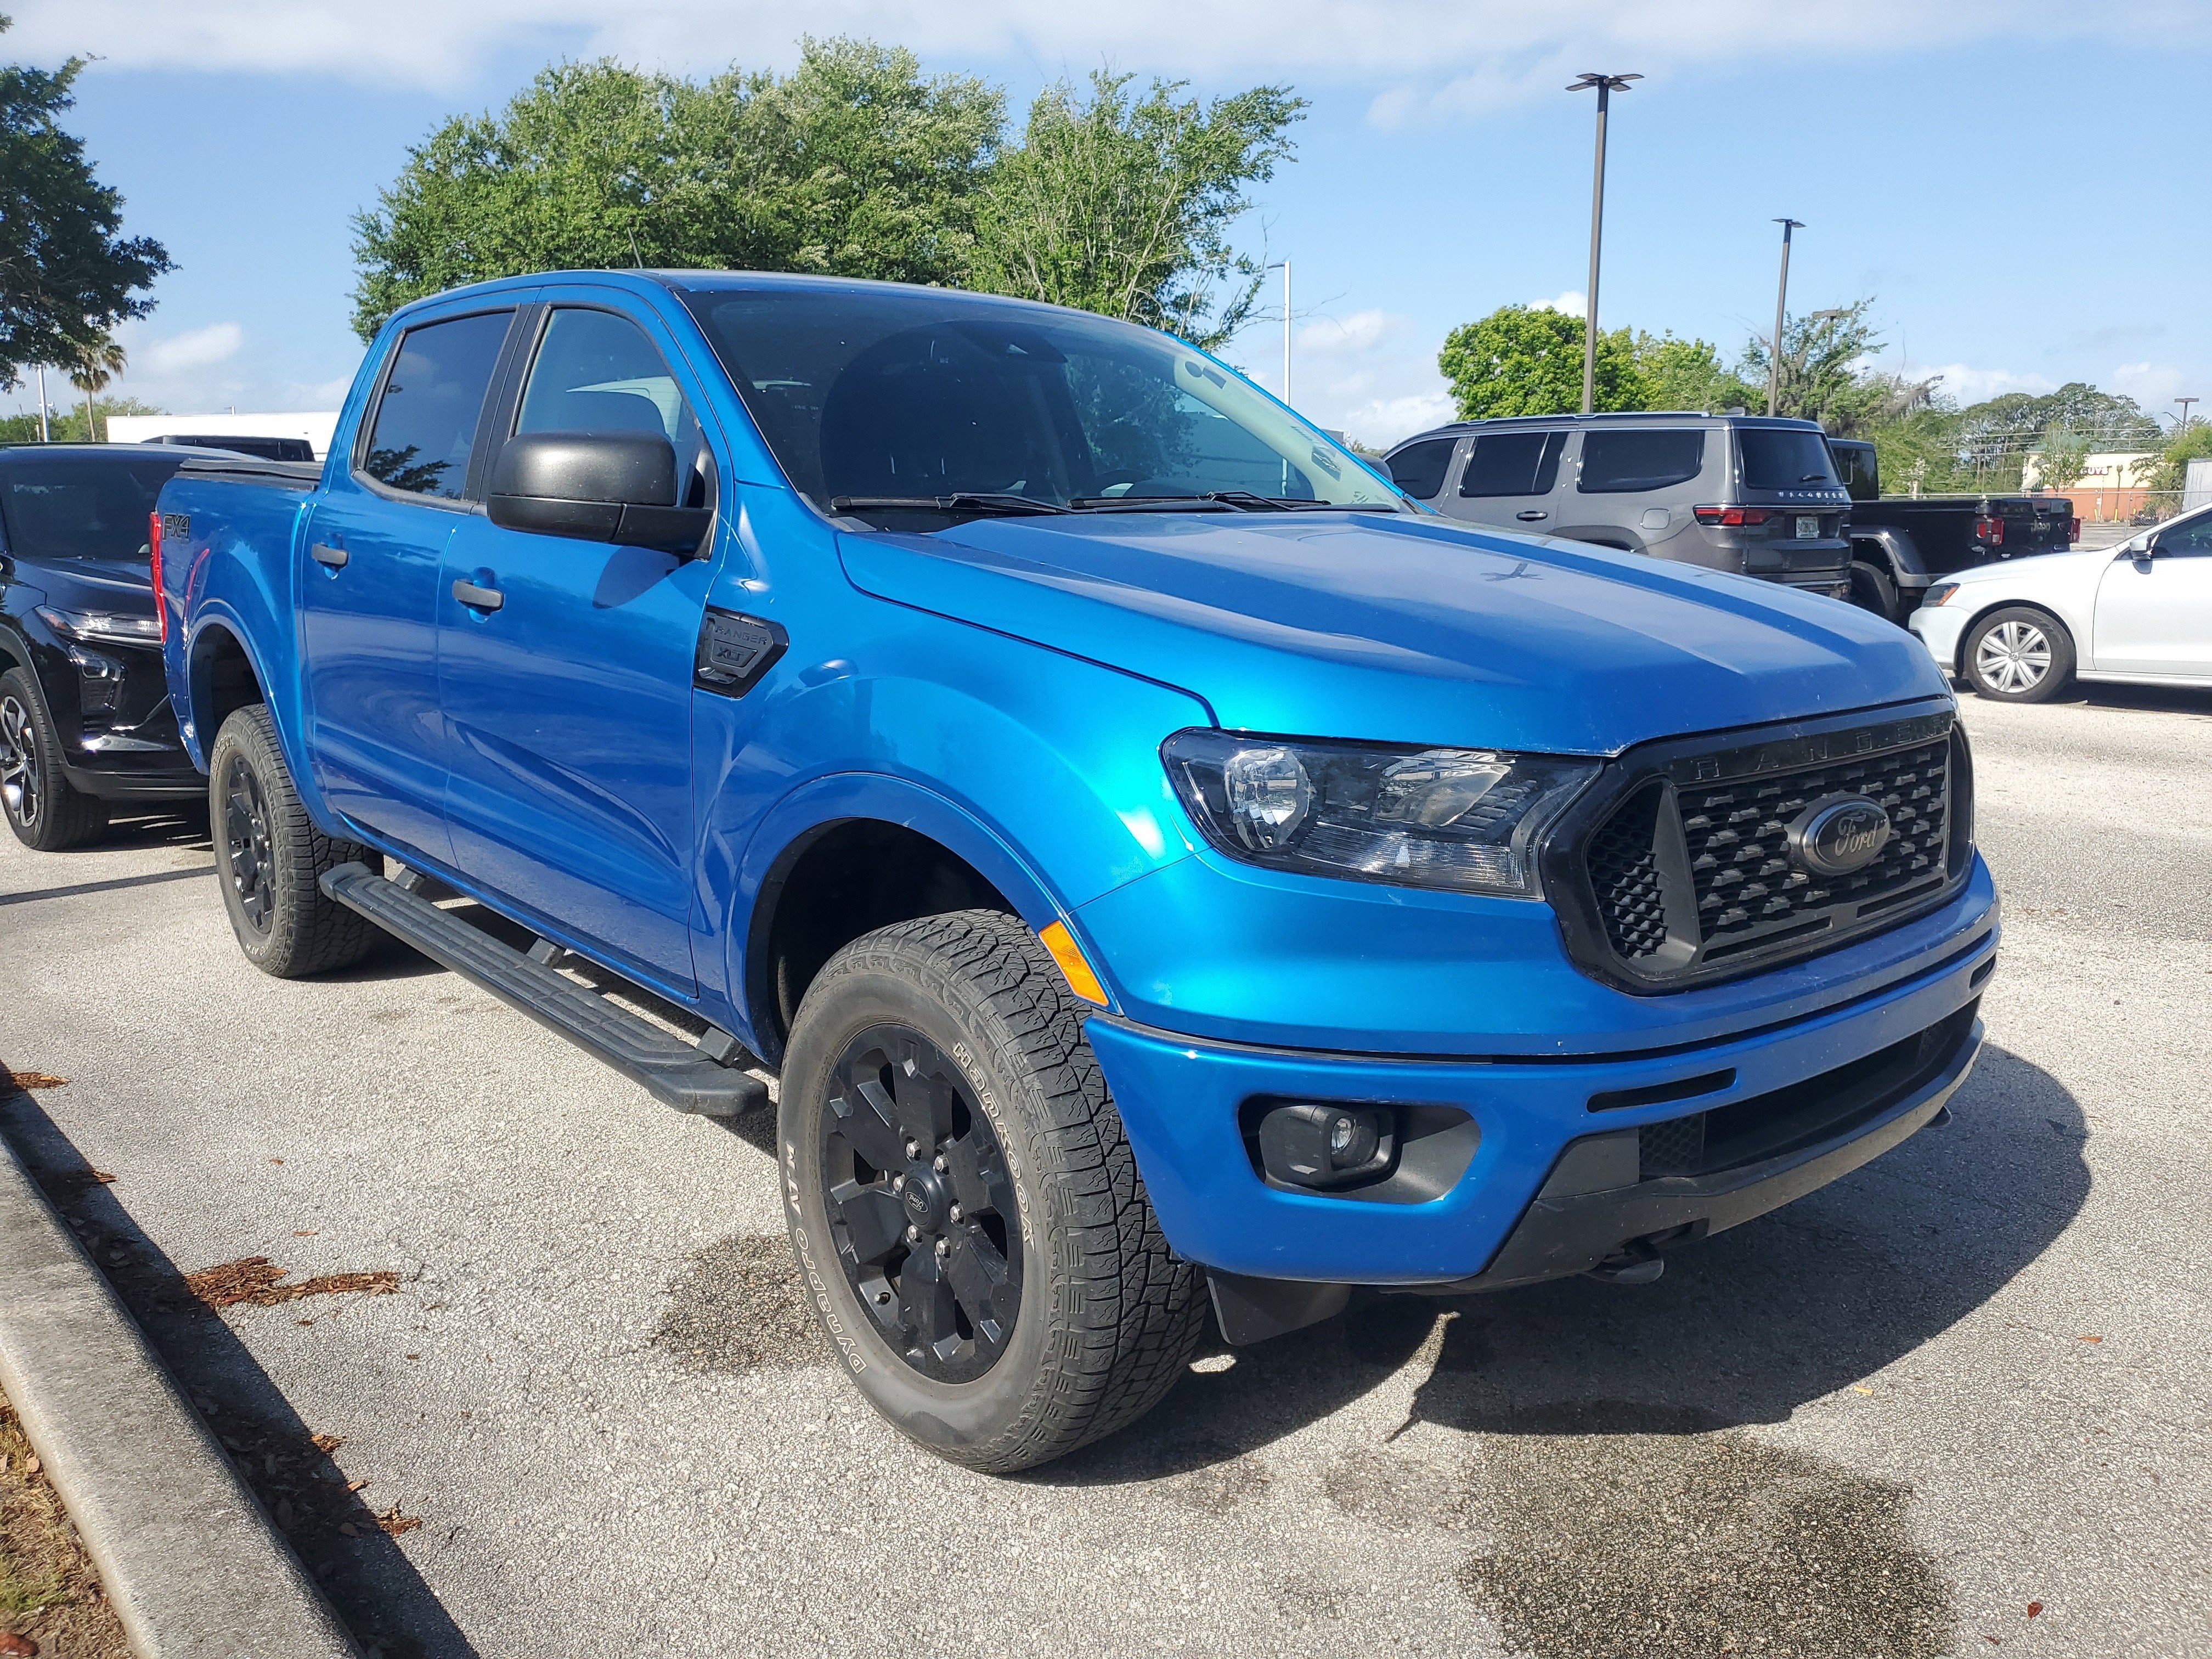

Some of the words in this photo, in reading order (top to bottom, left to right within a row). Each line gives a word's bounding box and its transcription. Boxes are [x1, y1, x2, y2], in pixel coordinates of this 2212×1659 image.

[162, 513, 190, 540] FX4
[715, 625, 768, 645] RANGER
[716, 646, 744, 662] XLT
[1835, 814, 1878, 856] Ford
